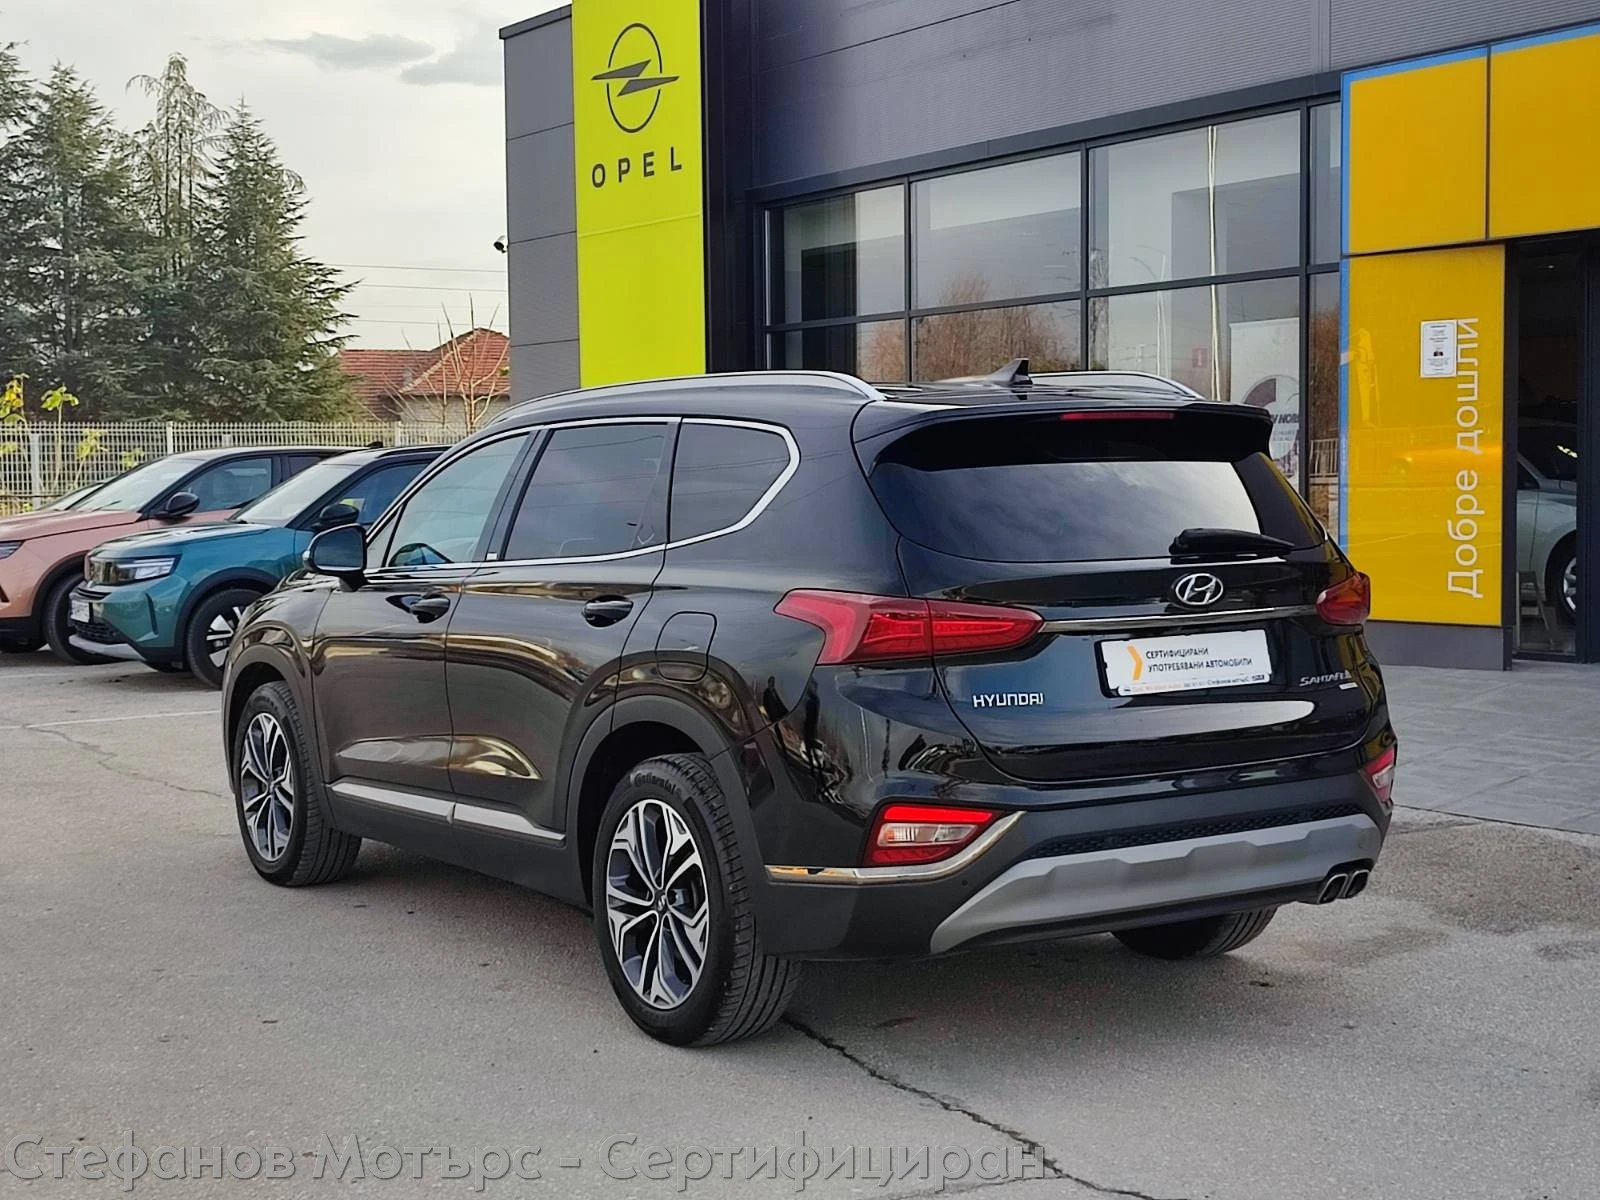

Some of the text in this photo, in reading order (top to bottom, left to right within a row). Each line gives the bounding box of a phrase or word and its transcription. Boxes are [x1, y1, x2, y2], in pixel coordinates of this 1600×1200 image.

[592, 146, 682, 188] OPEL
[1447, 318, 1485, 599] Добре дошли
[1145, 647, 1209, 660] СЕРТИФИЦИРАНИ
[1148, 657, 1252, 673] УПОТРЕБЯВАНИ АВТОМОБИЛИ
[972, 692, 1044, 708] HYUNDAI
